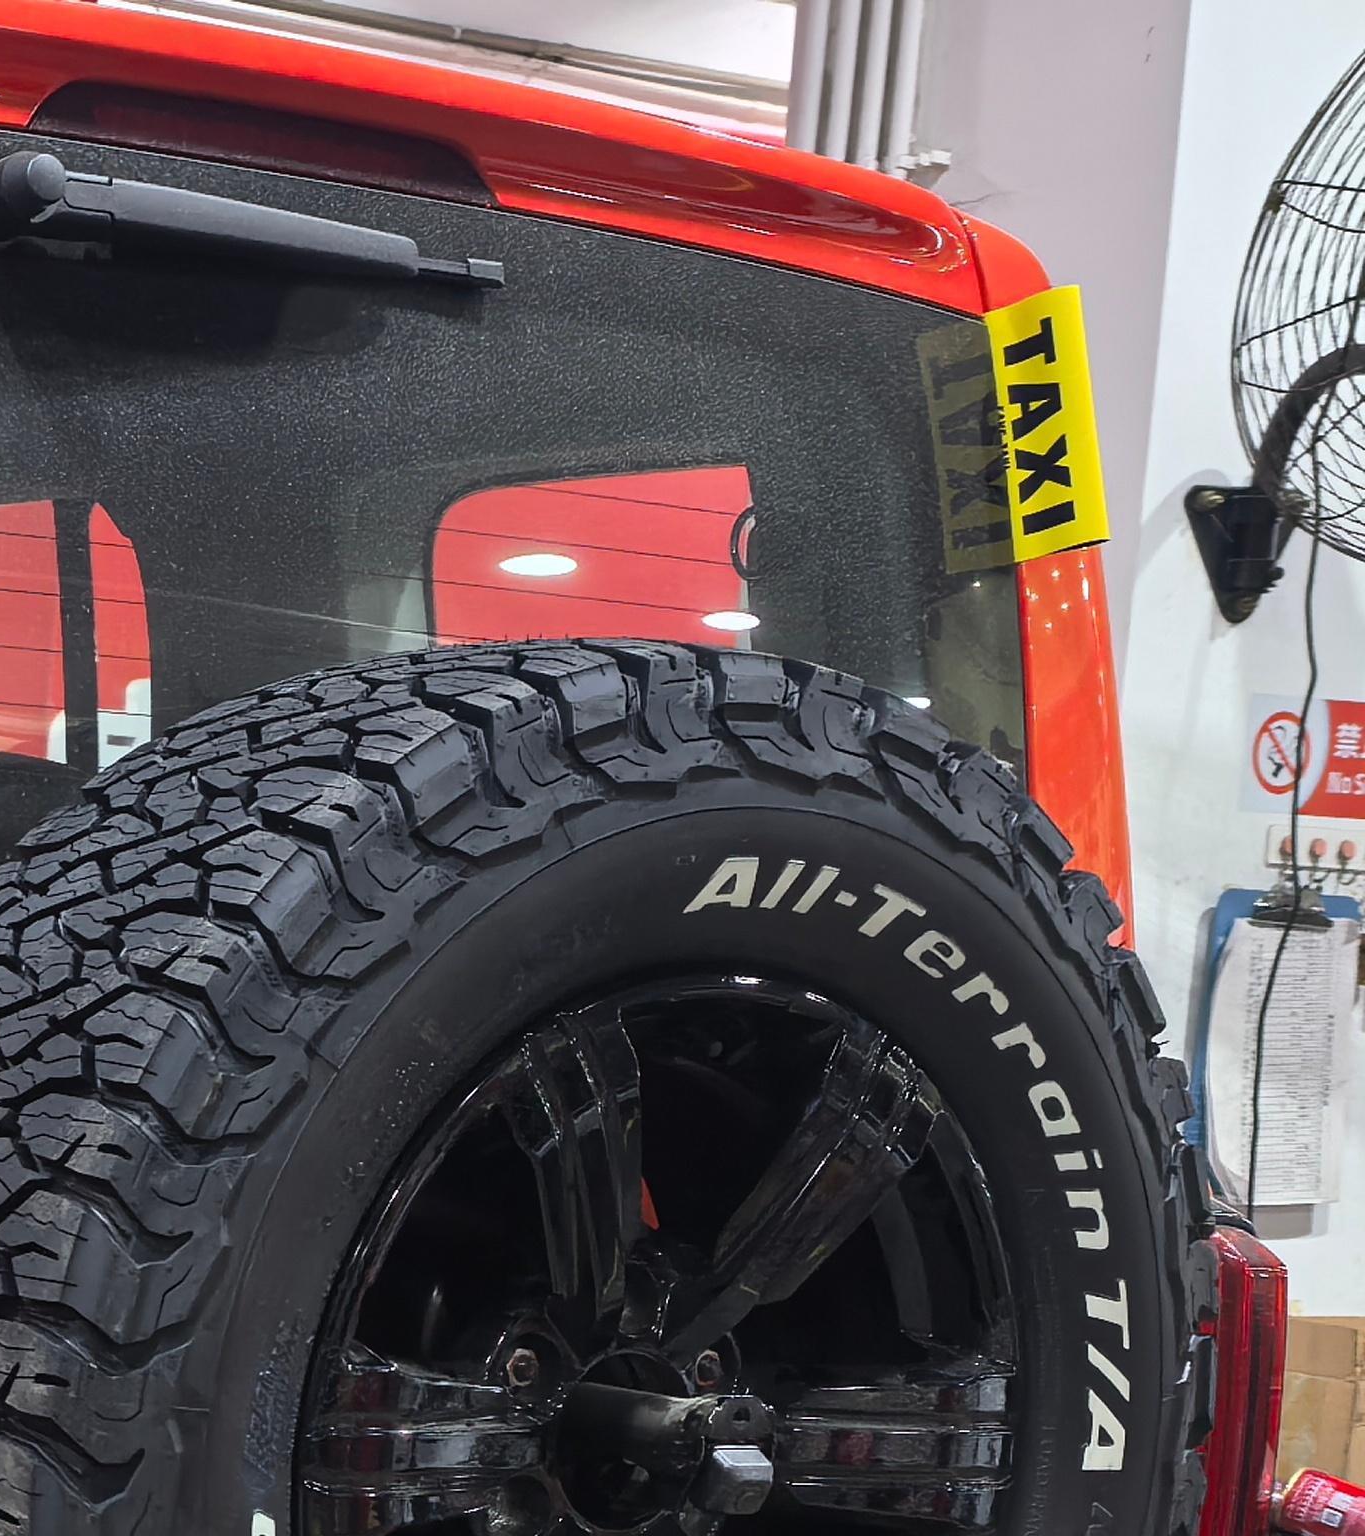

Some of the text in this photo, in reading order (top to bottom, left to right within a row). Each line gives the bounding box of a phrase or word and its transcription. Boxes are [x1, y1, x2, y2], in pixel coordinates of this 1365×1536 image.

[1004, 316, 1076, 535] TAXI
[682, 856, 1130, 1471] All-Terrain T/A
